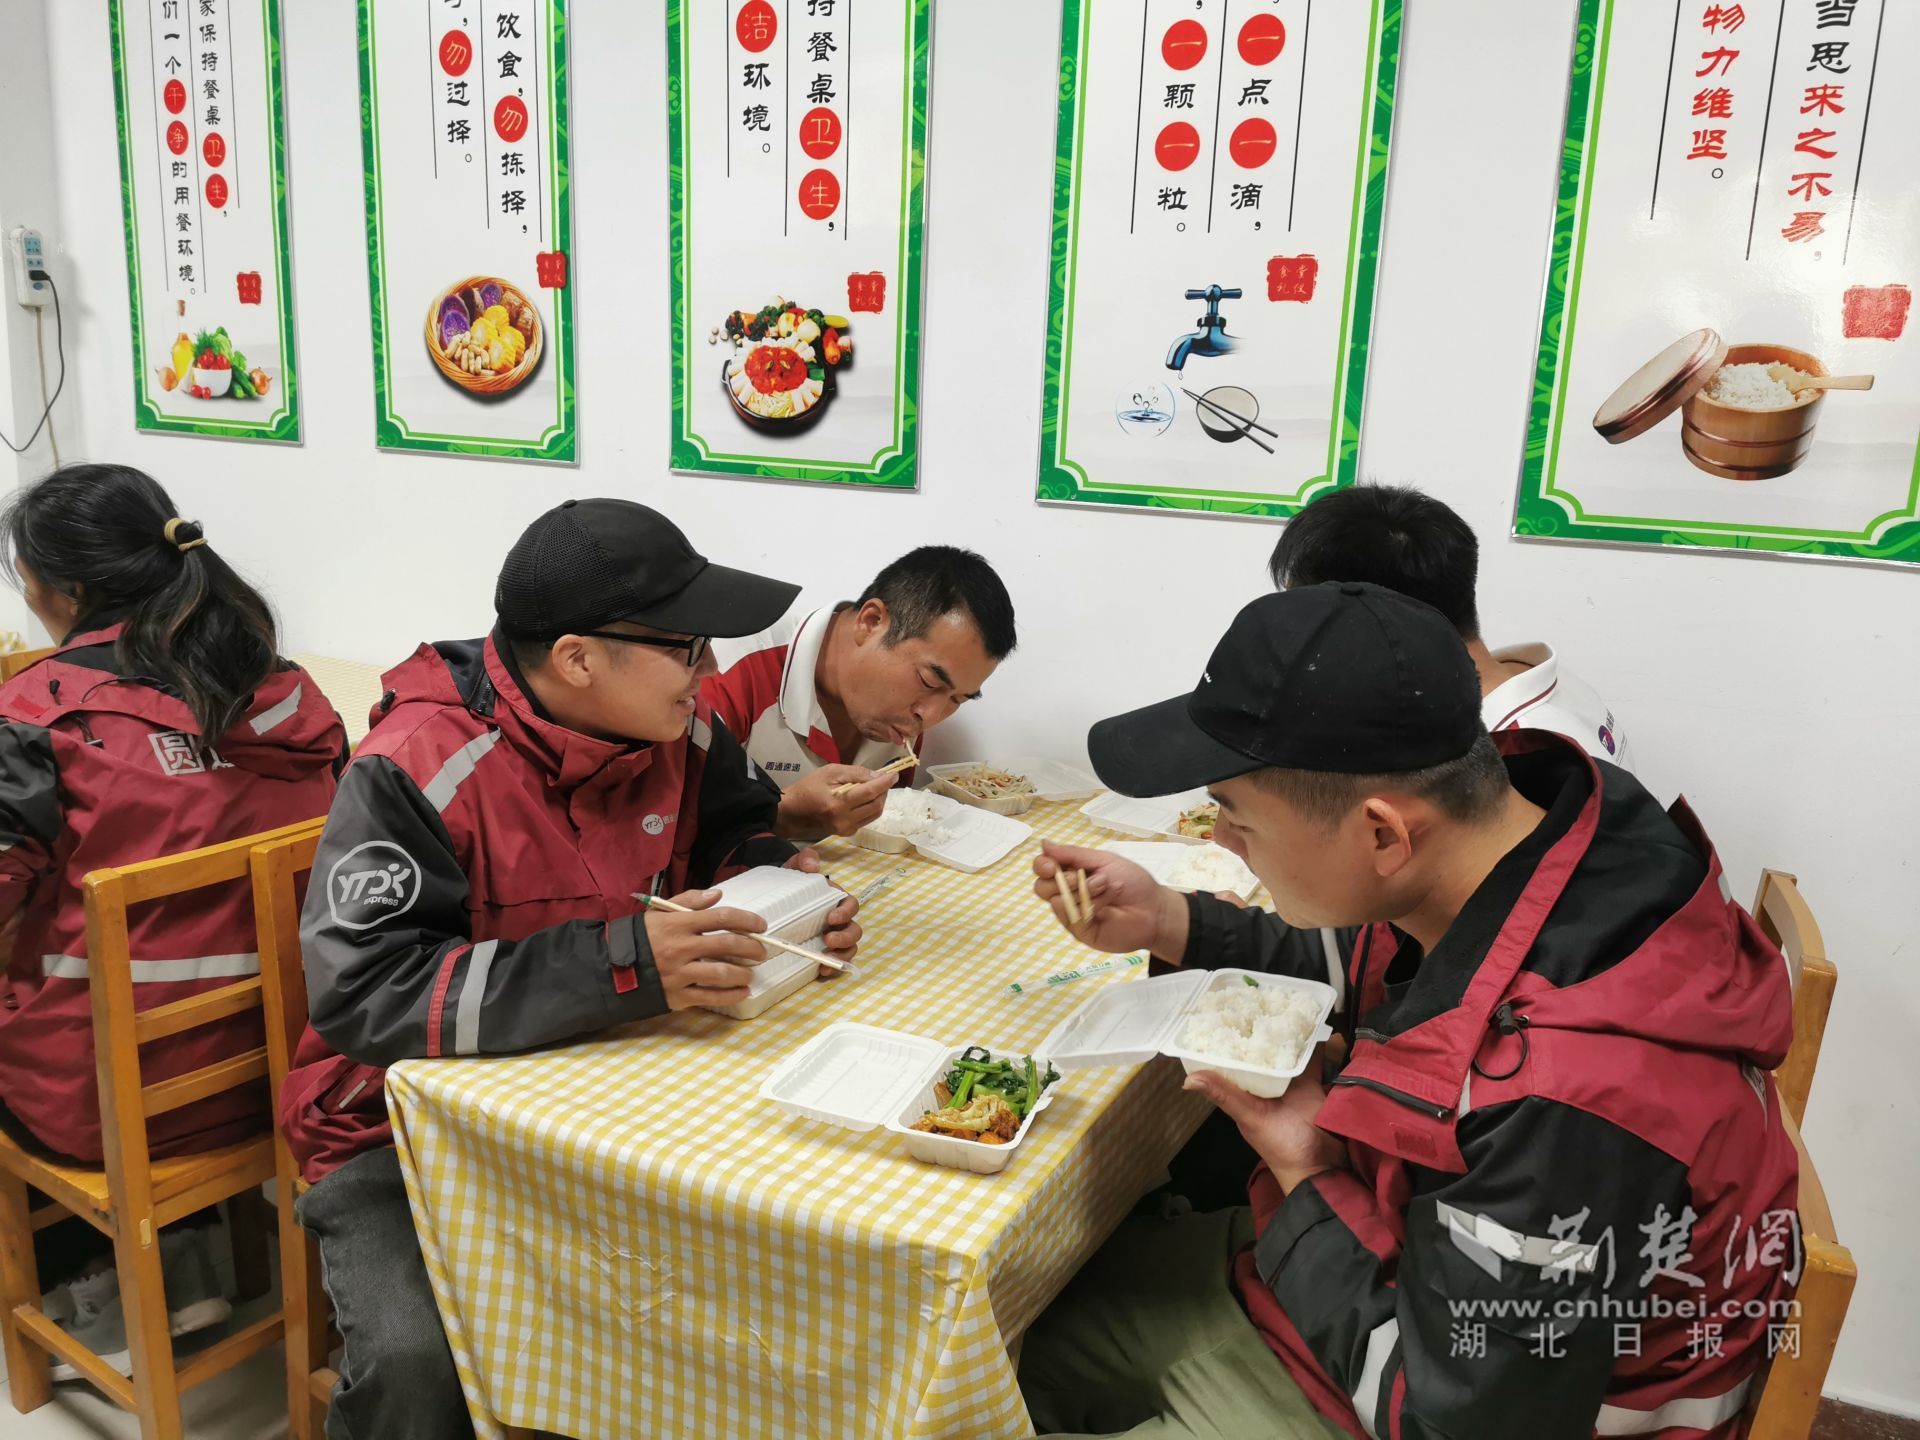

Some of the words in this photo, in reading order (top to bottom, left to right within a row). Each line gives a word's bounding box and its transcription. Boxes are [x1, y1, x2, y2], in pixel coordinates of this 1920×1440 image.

[443, 0, 473, 163] ，勿过择。
[147, 730, 235, 776] 圆
